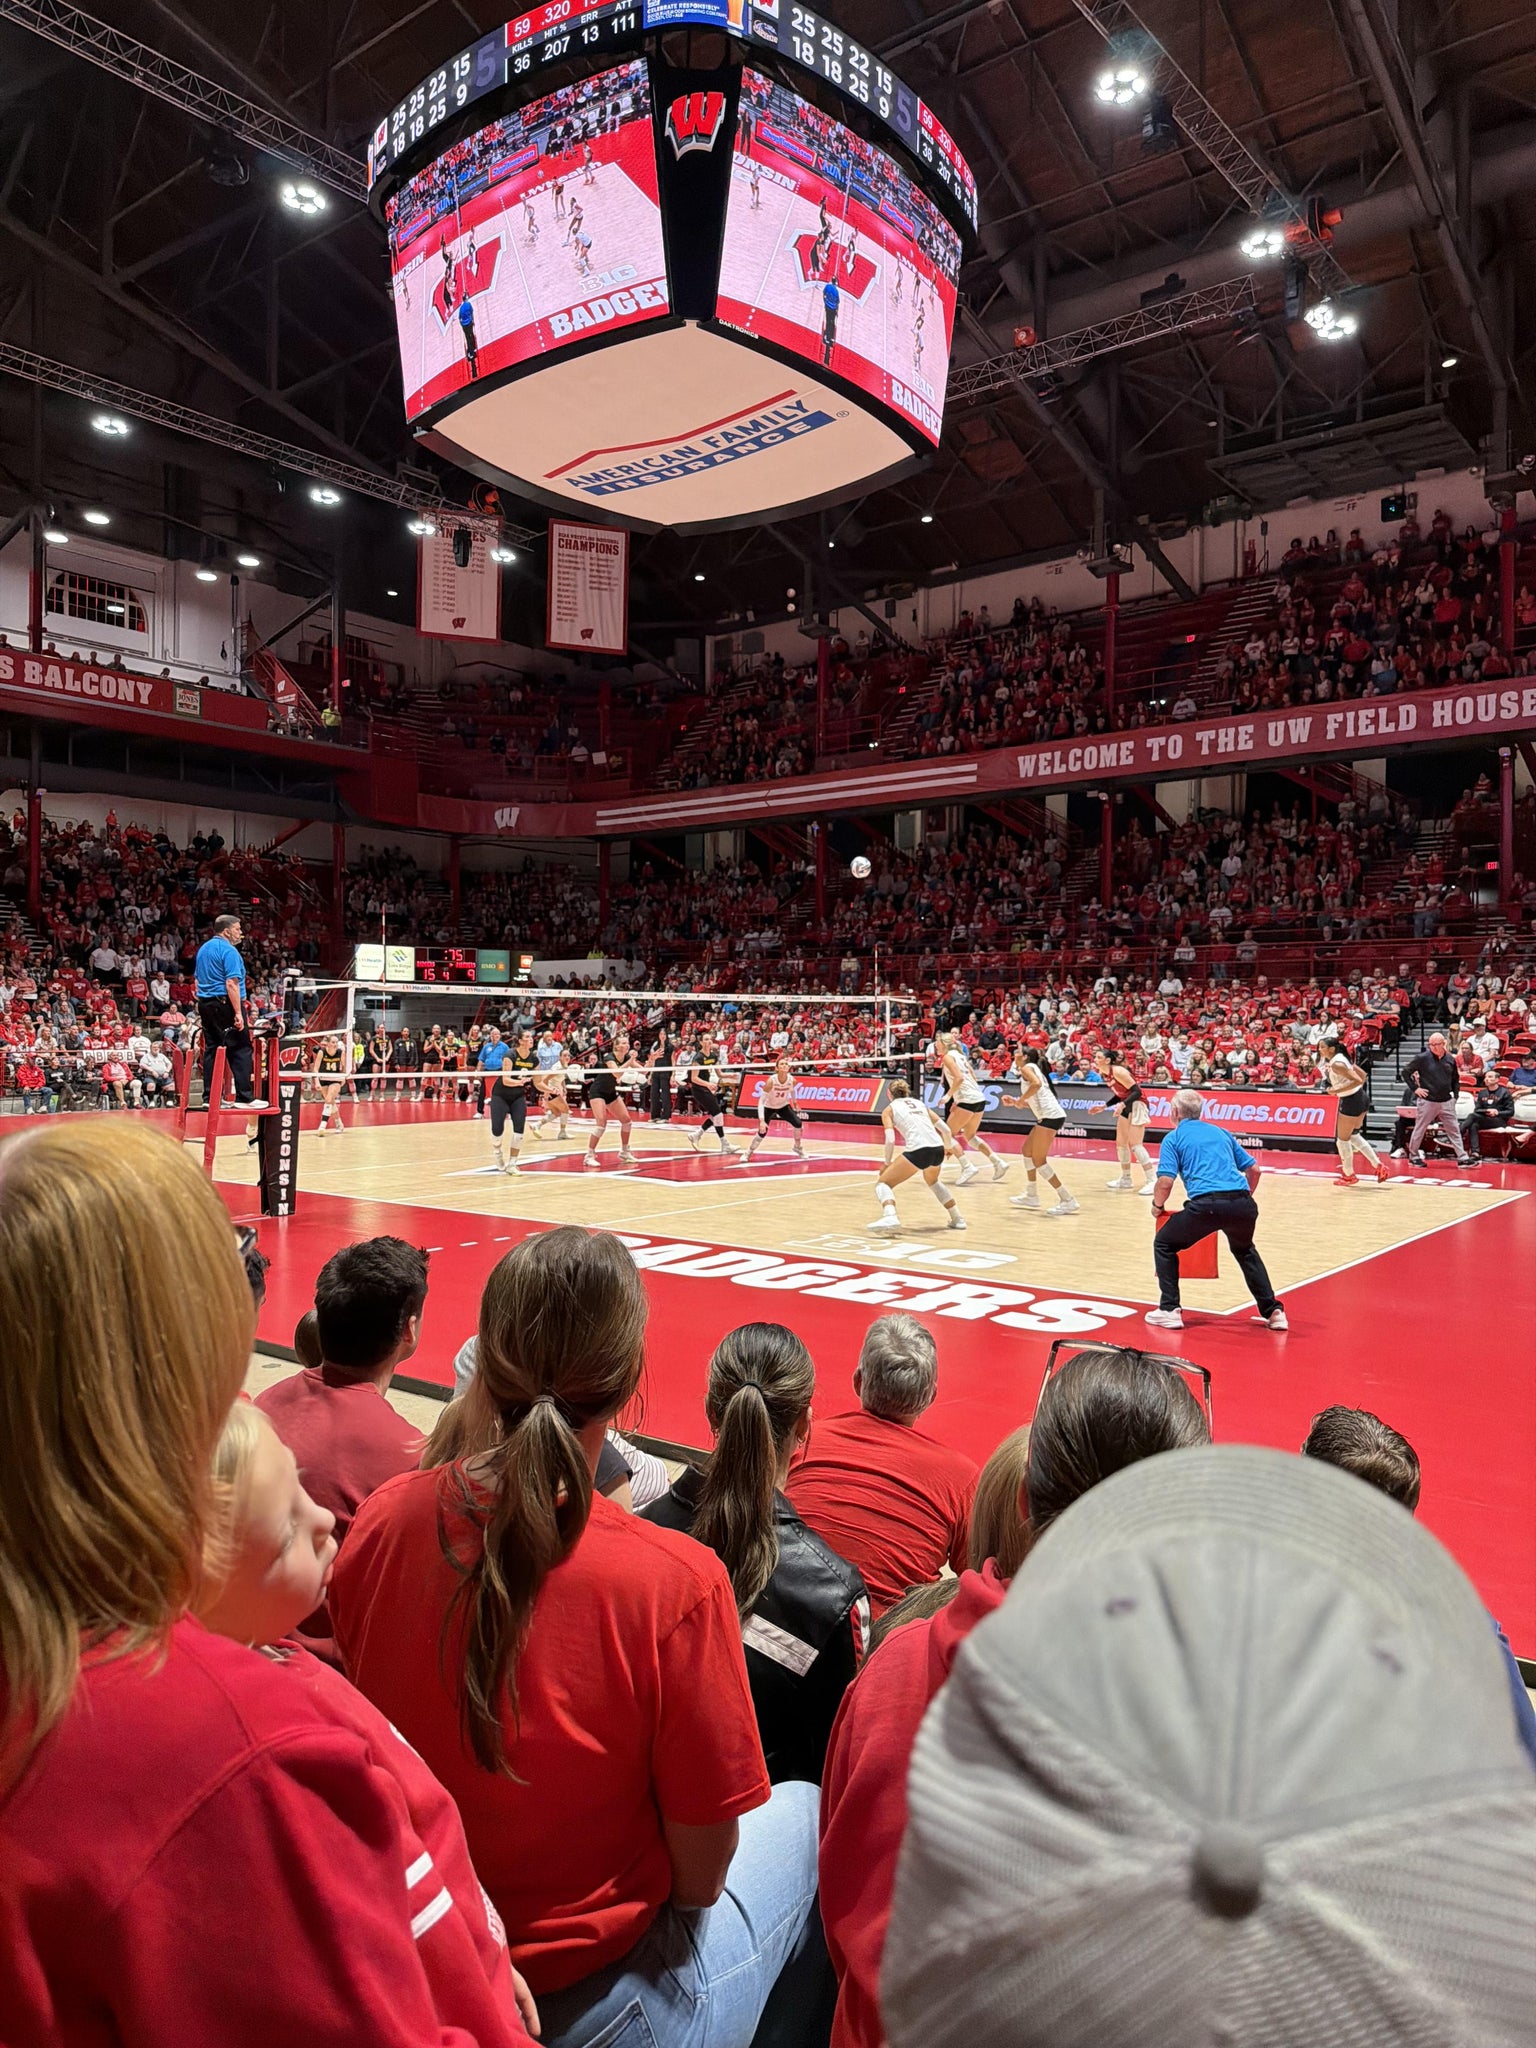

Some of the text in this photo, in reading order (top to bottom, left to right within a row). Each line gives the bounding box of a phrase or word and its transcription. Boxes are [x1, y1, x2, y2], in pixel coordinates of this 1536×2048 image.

[512, 38, 533, 54] KILLS
[544, 26, 557, 39] HIT
[560, 23, 567, 32] %
[580, 11, 598, 24] ERR
[614, 0, 633, 12] ATT
[514, 0, 570, 37] 59 .320
[647, 4, 678, 14] CELEBRATE
[514, 13, 635, 73] 36 .207 13 111
[792, 8, 816, 38] 25
[821, 26, 843, 56] 25
[848, 45, 870, 77] 22
[876, 66, 892, 95] 15
[392, 42, 496, 134] 25 25 22 15 5
[792, 36, 890, 119] 18 18 25 9
[393, 84, 467, 158] 18 18 25 9
[579, 264, 638, 295] BIG
[719, 318, 759, 340] DAKTRONICS
[564, 399, 810, 489] AMERICAN FAMILY
[600, 421, 813, 493] INSURANCE
[558, 538, 620, 556] CHAMPIONS
[24, 660, 153, 705] BALCONY
[1018, 687, 1536, 779] WELCOME TO THE UW FIELD HOUSE
[424, 968, 476, 981] 15 4 9
[326, 1062, 337, 1071] 14
[752, 1080, 870, 1102] SKunes.com
[904, 1100, 916, 1109] 5
[1147, 1096, 1326, 1126] ShKunes.com
[278, 1085, 295, 1215] WISCONSIN
[1234, 1137, 1264, 1148] ealth
[782, 1234, 1019, 1270] BIG
